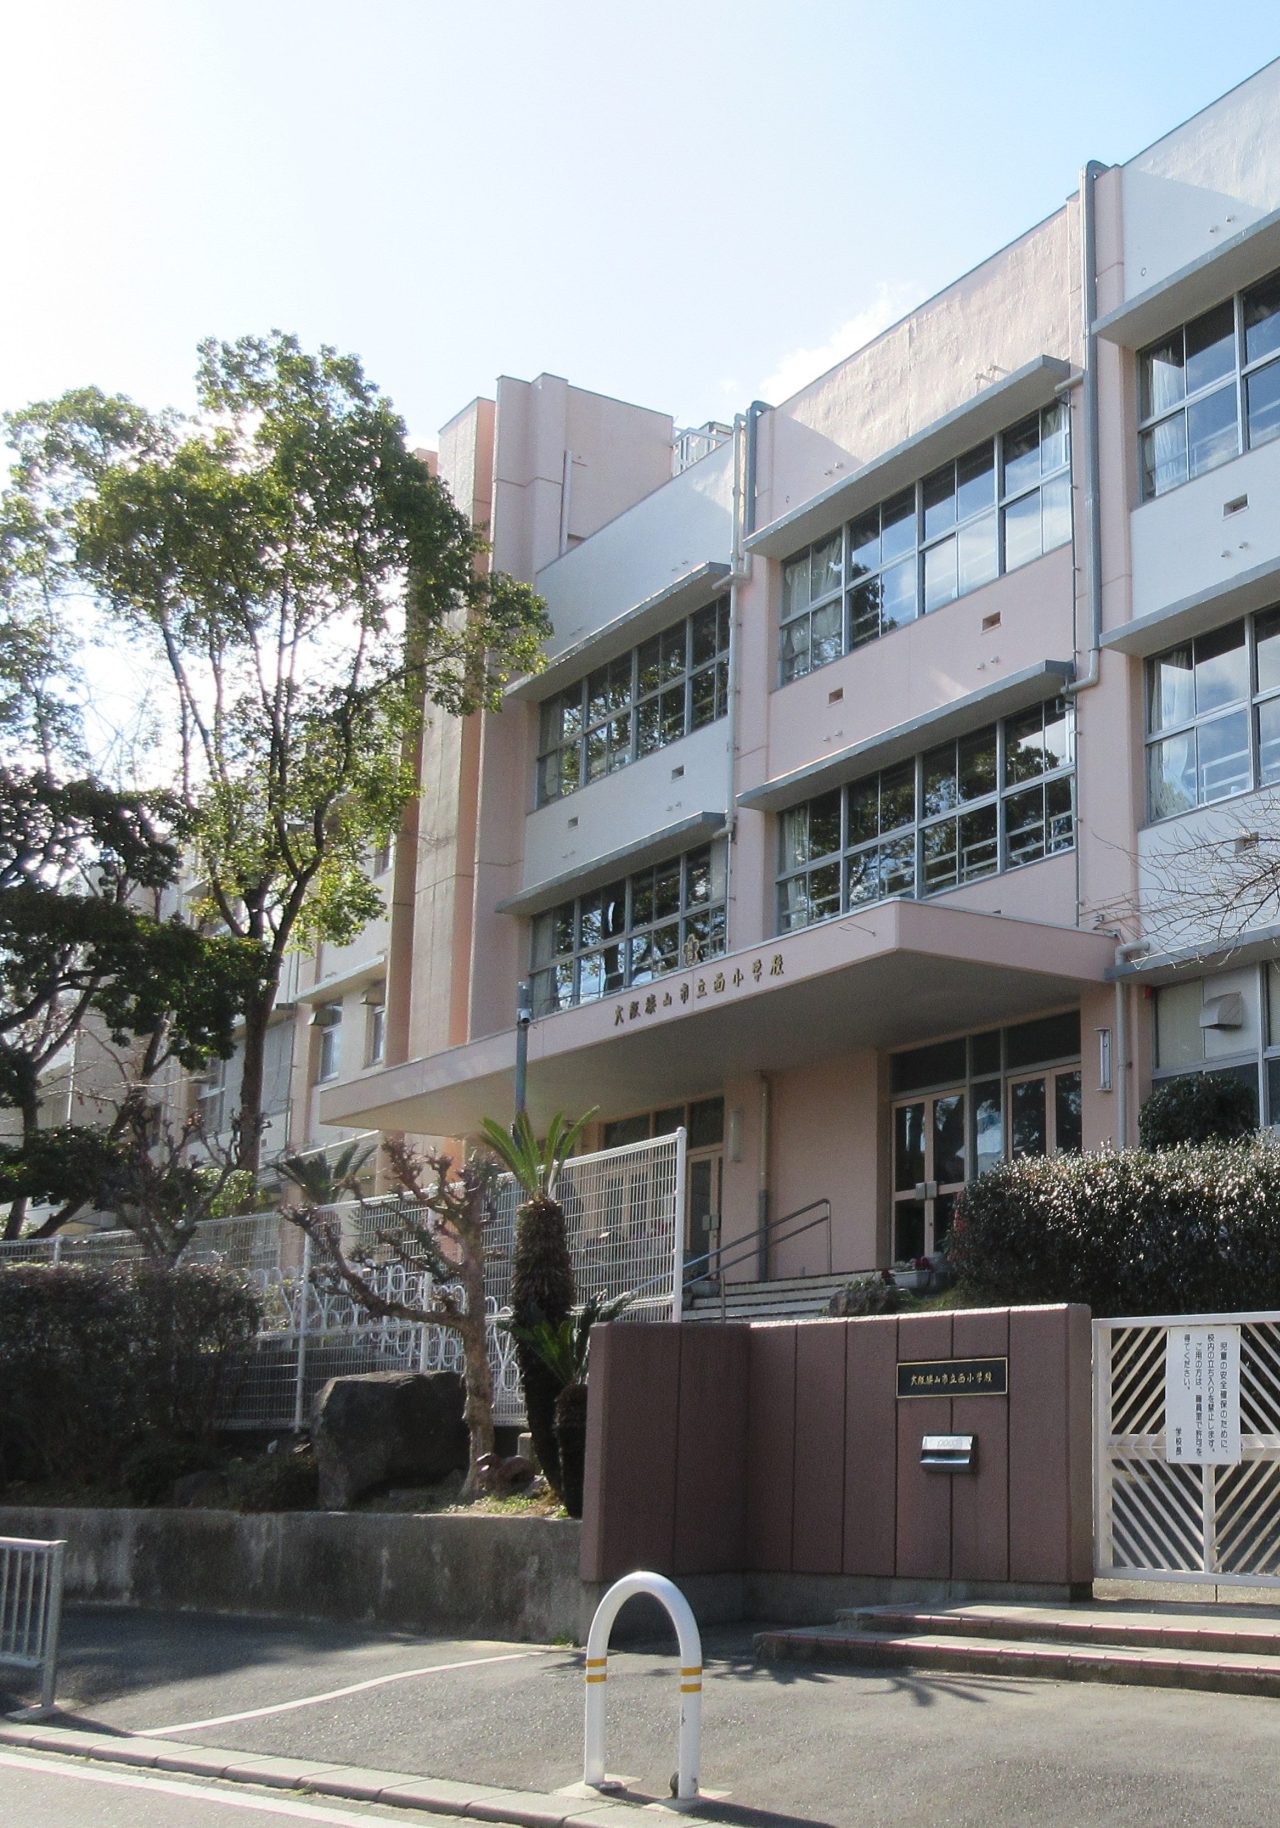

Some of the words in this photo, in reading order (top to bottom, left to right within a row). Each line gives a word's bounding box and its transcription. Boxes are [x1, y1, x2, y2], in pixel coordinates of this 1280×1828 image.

[1207, 1333, 1216, 1453] 校内の立ち入りを禁止します。
[1220, 1341, 1228, 1454] 児童の安全確保のために、
